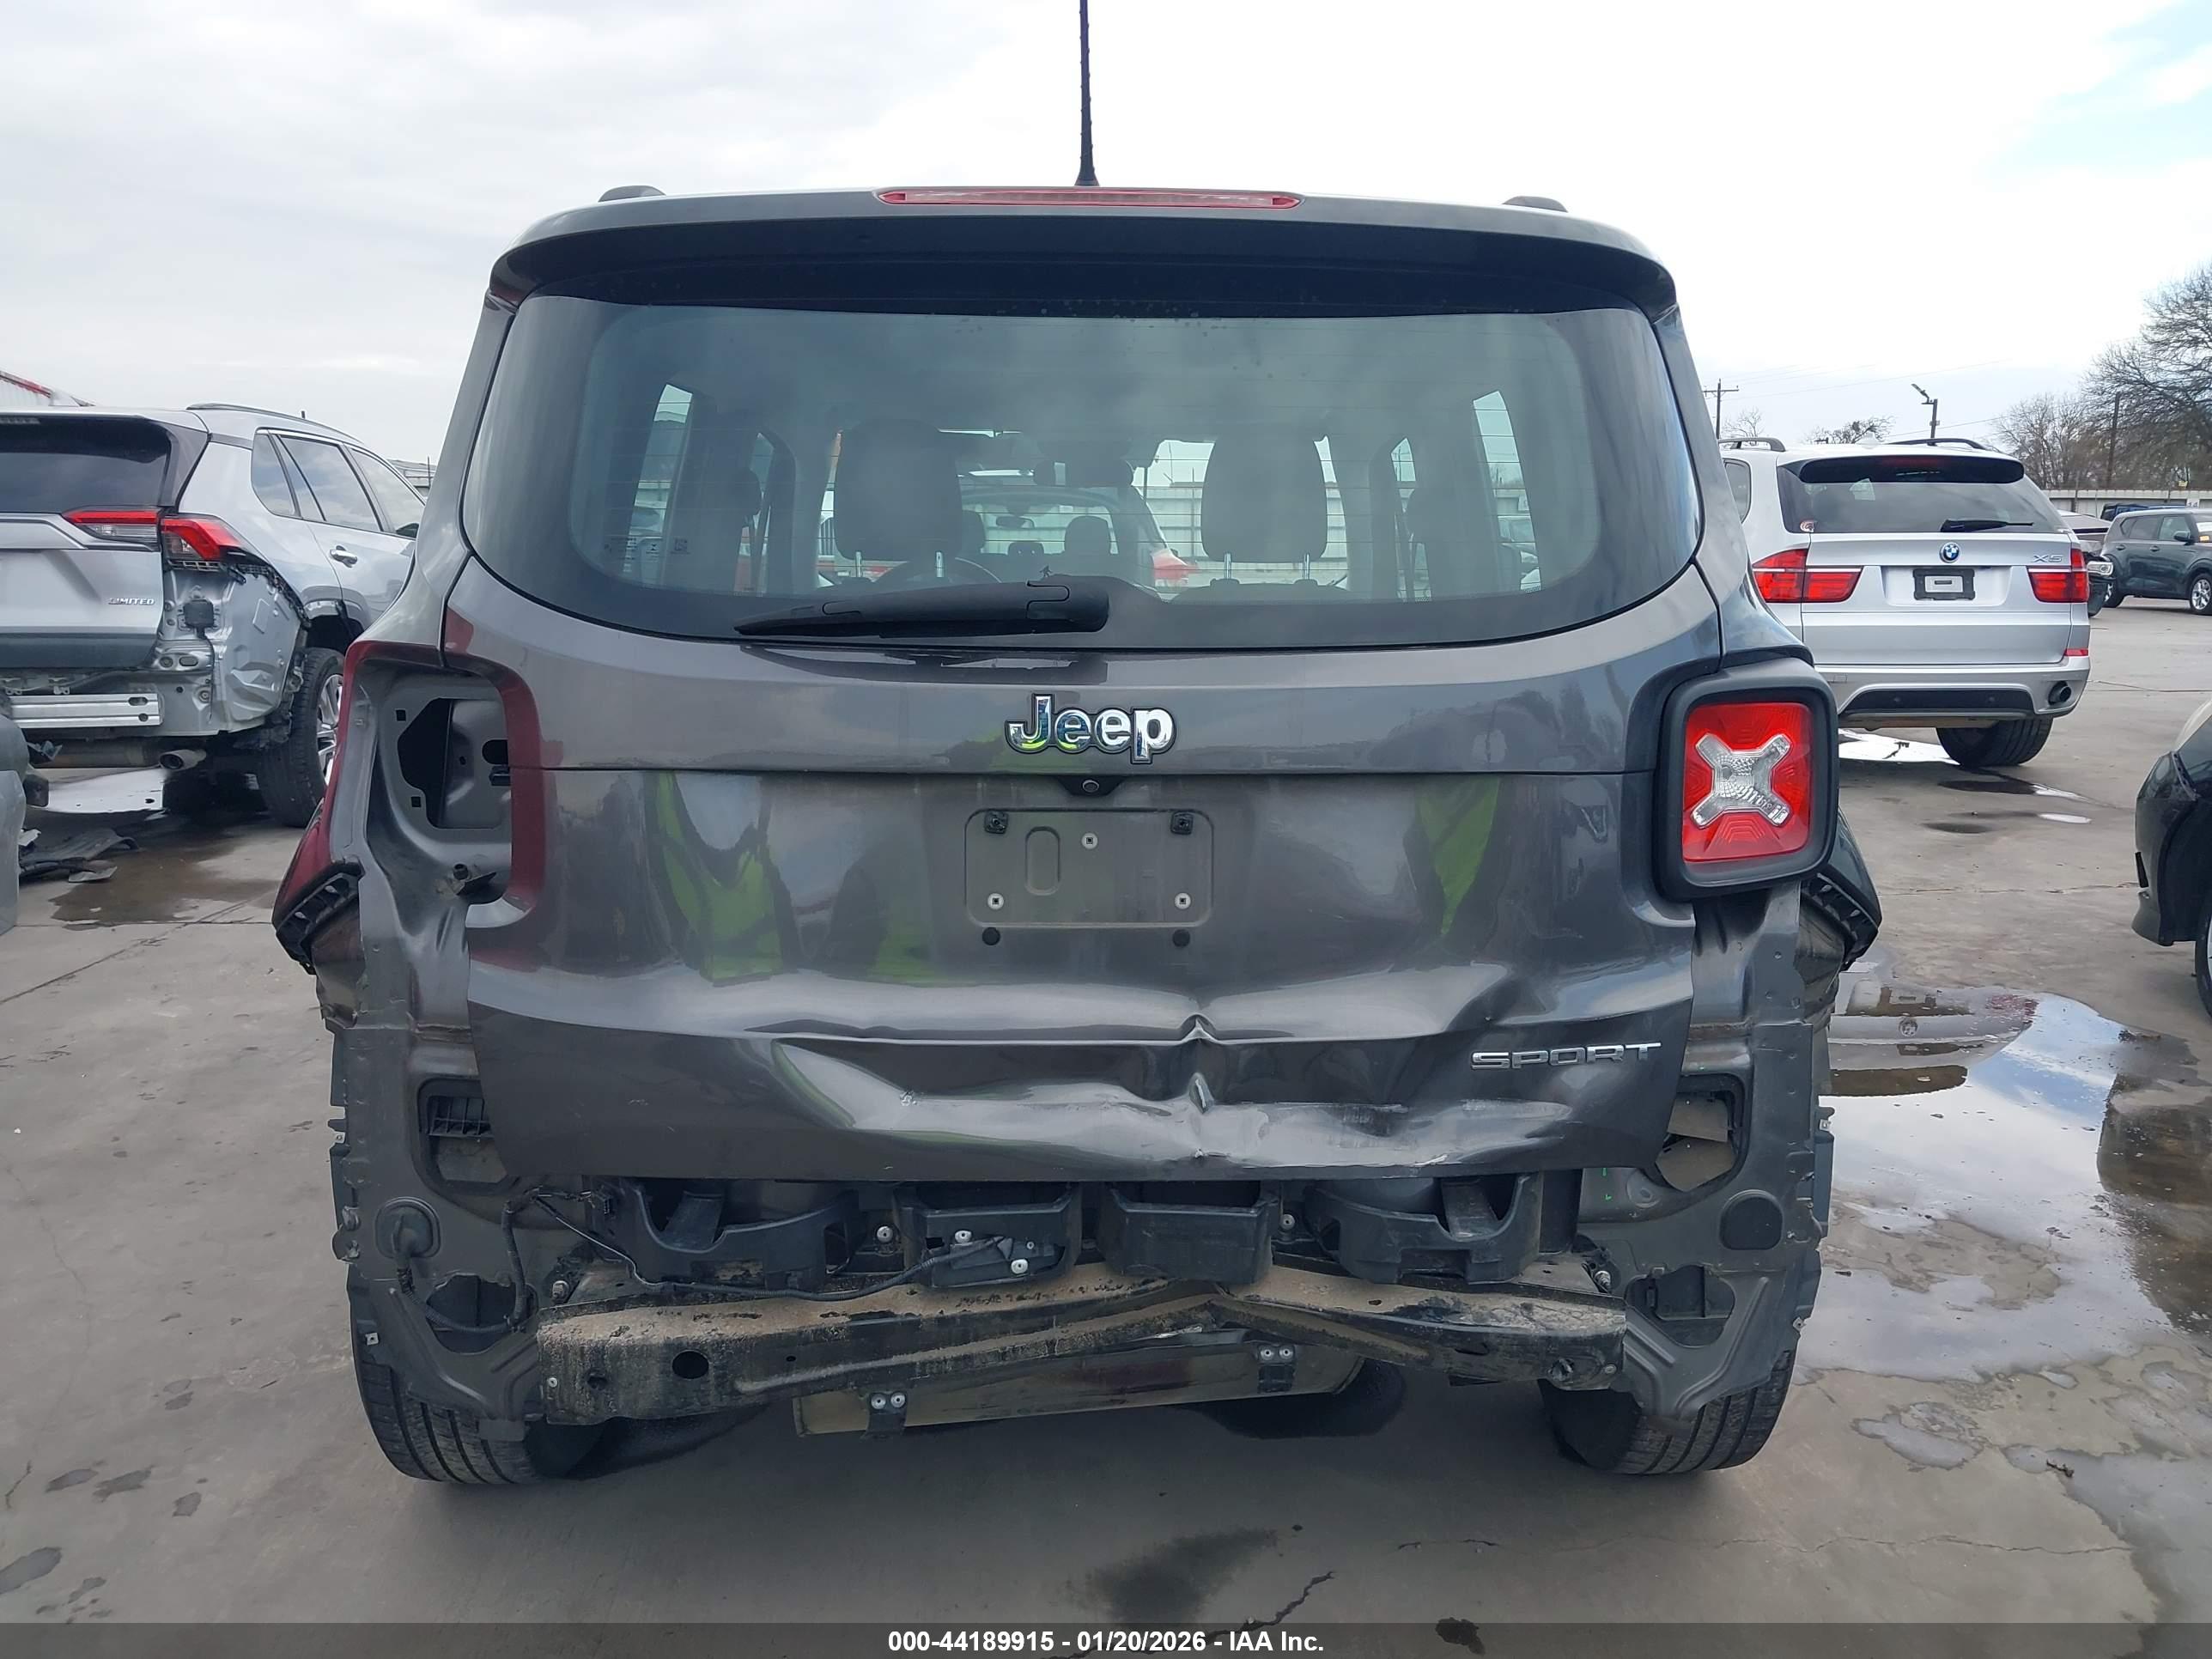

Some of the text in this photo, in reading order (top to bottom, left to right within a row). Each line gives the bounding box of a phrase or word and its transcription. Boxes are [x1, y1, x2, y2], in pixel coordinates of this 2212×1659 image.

[2031, 554, 2063, 563] X5
[1006, 695, 1176, 763] Jeep
[1471, 1042, 1662, 1070] SPORT
